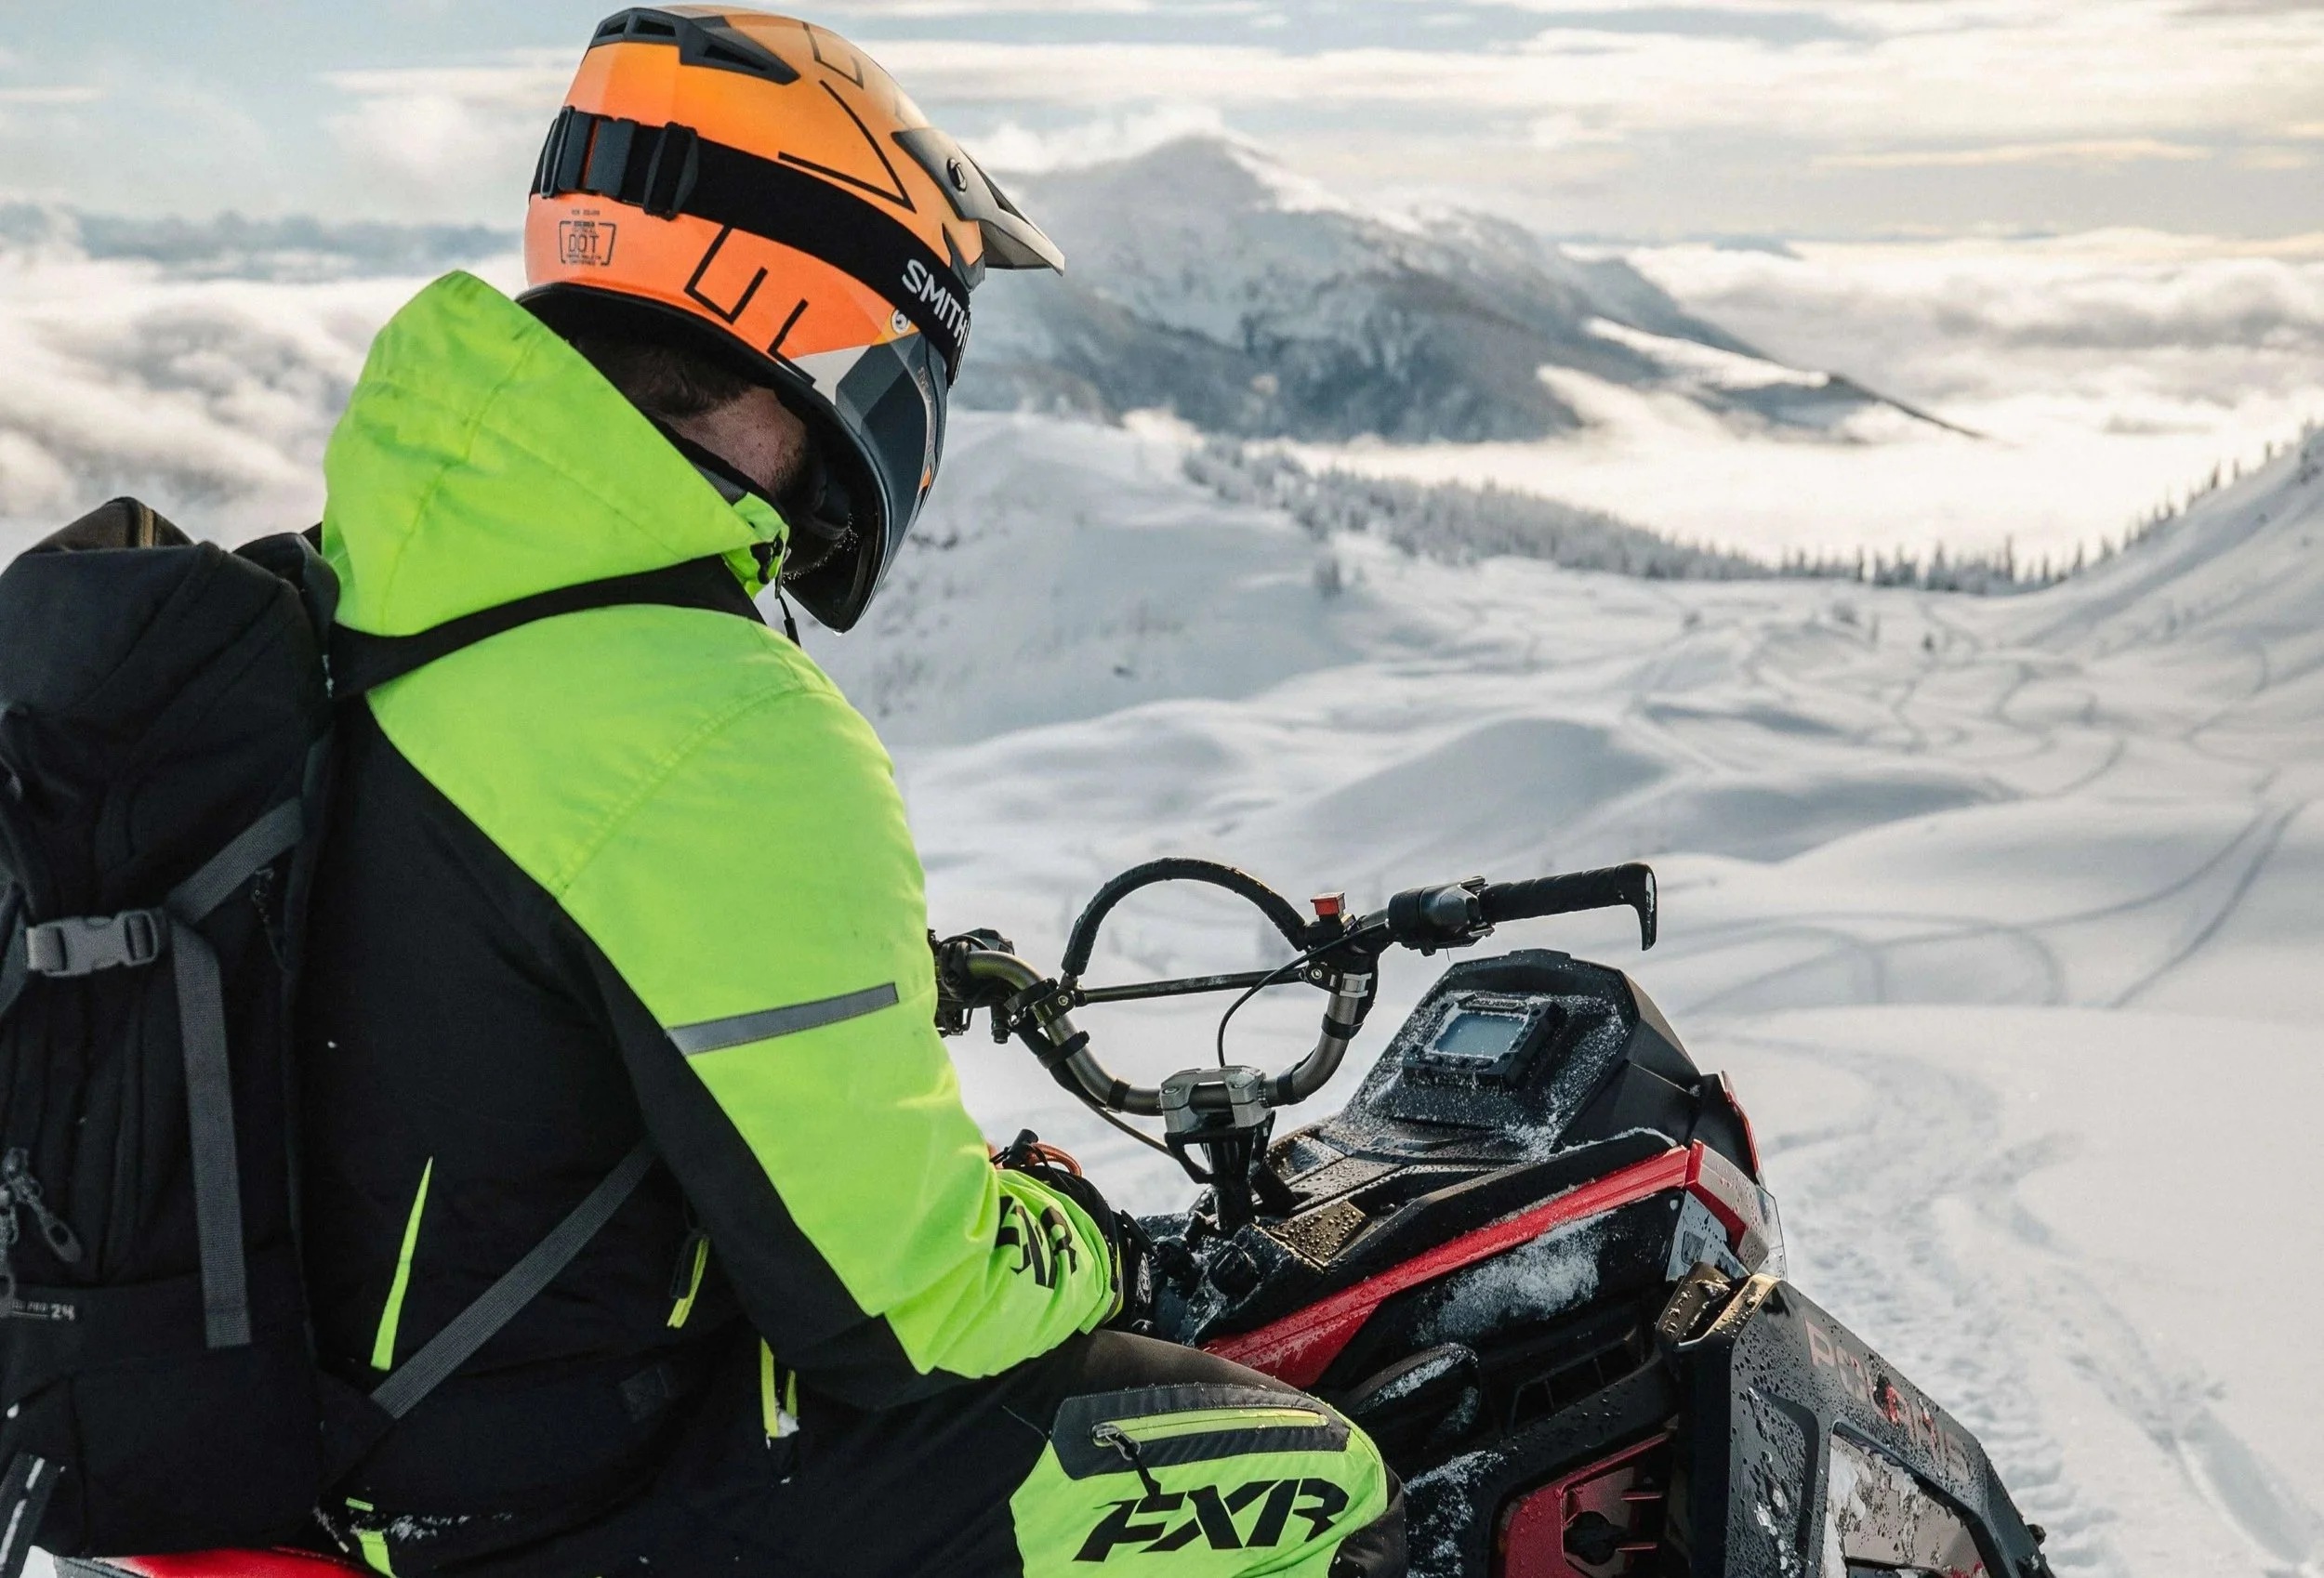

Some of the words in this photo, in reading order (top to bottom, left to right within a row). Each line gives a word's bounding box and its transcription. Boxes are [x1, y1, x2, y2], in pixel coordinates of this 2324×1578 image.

[569, 233, 600, 253] DOT
[902, 259, 968, 348] SMITH
[51, 1303, 75, 1321] 24
[1072, 1479, 1350, 1562] FXR
